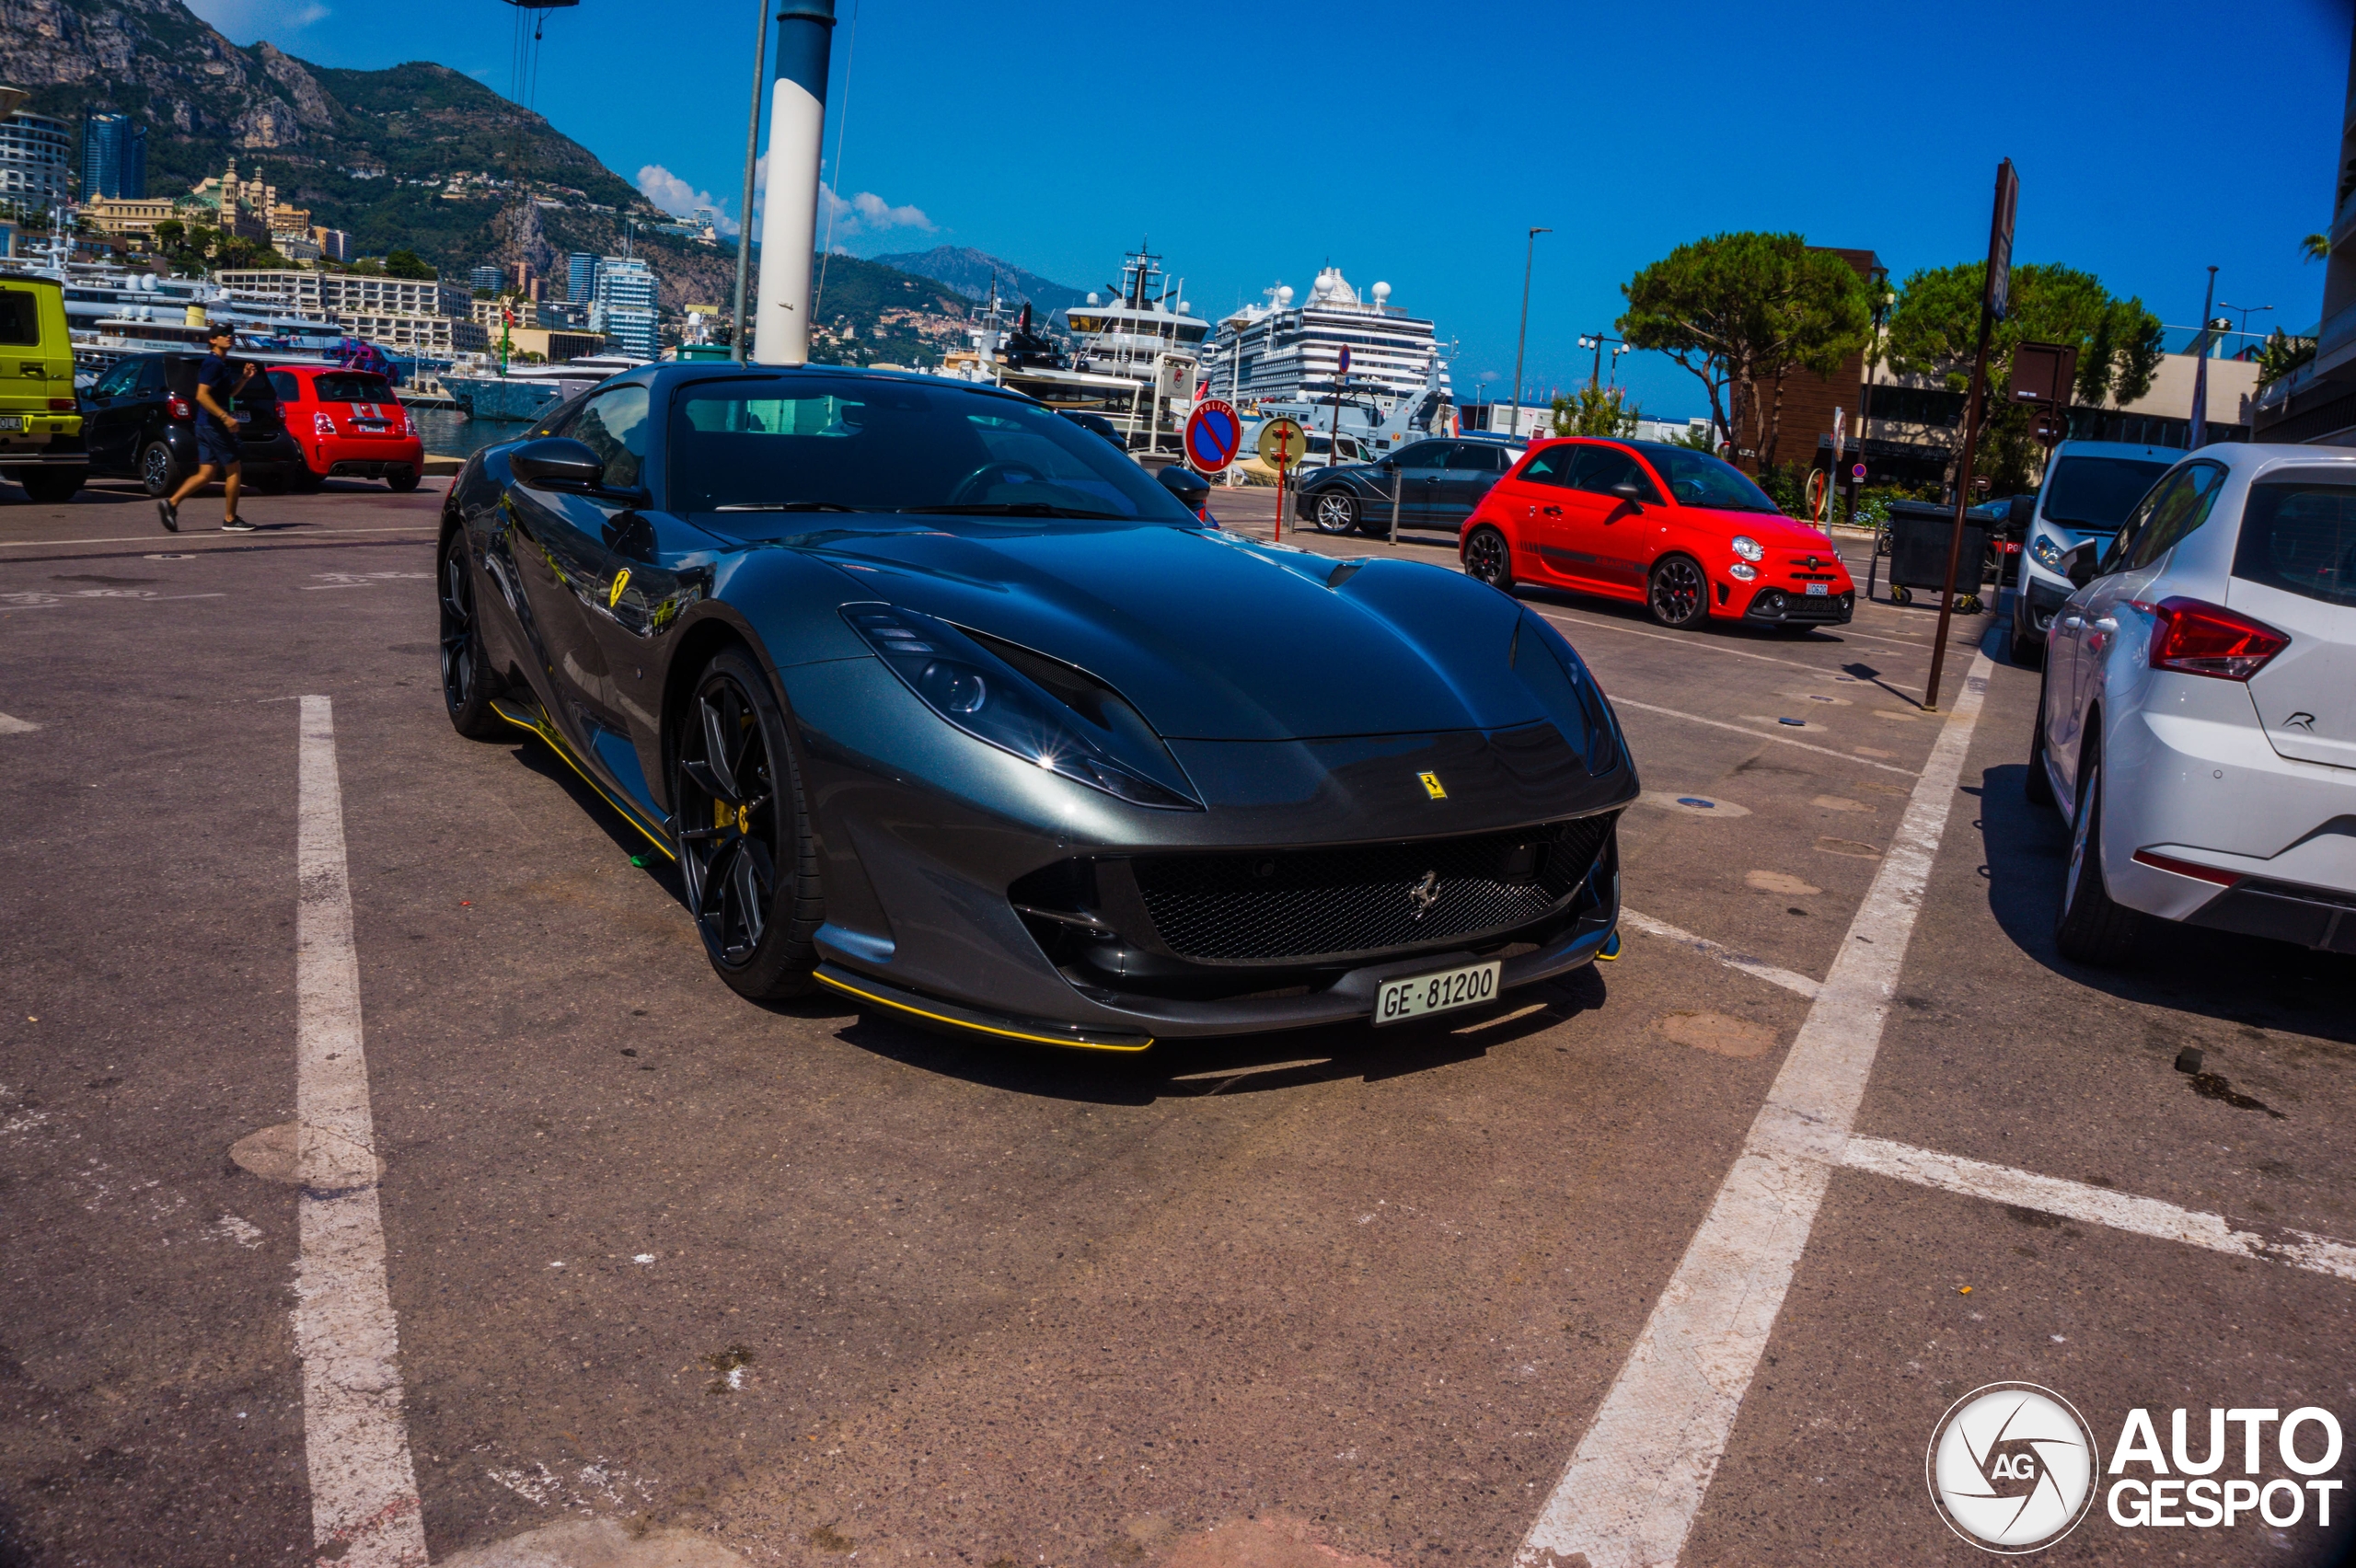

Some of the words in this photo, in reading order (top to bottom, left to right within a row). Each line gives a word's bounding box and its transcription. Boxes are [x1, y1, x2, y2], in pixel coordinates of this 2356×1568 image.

[1198, 402, 1232, 417] POLICE
[1883, 444, 1911, 454] SCHOOL
[1914, 447, 1923, 455] OF
[1595, 556, 1634, 571] ABARTH
